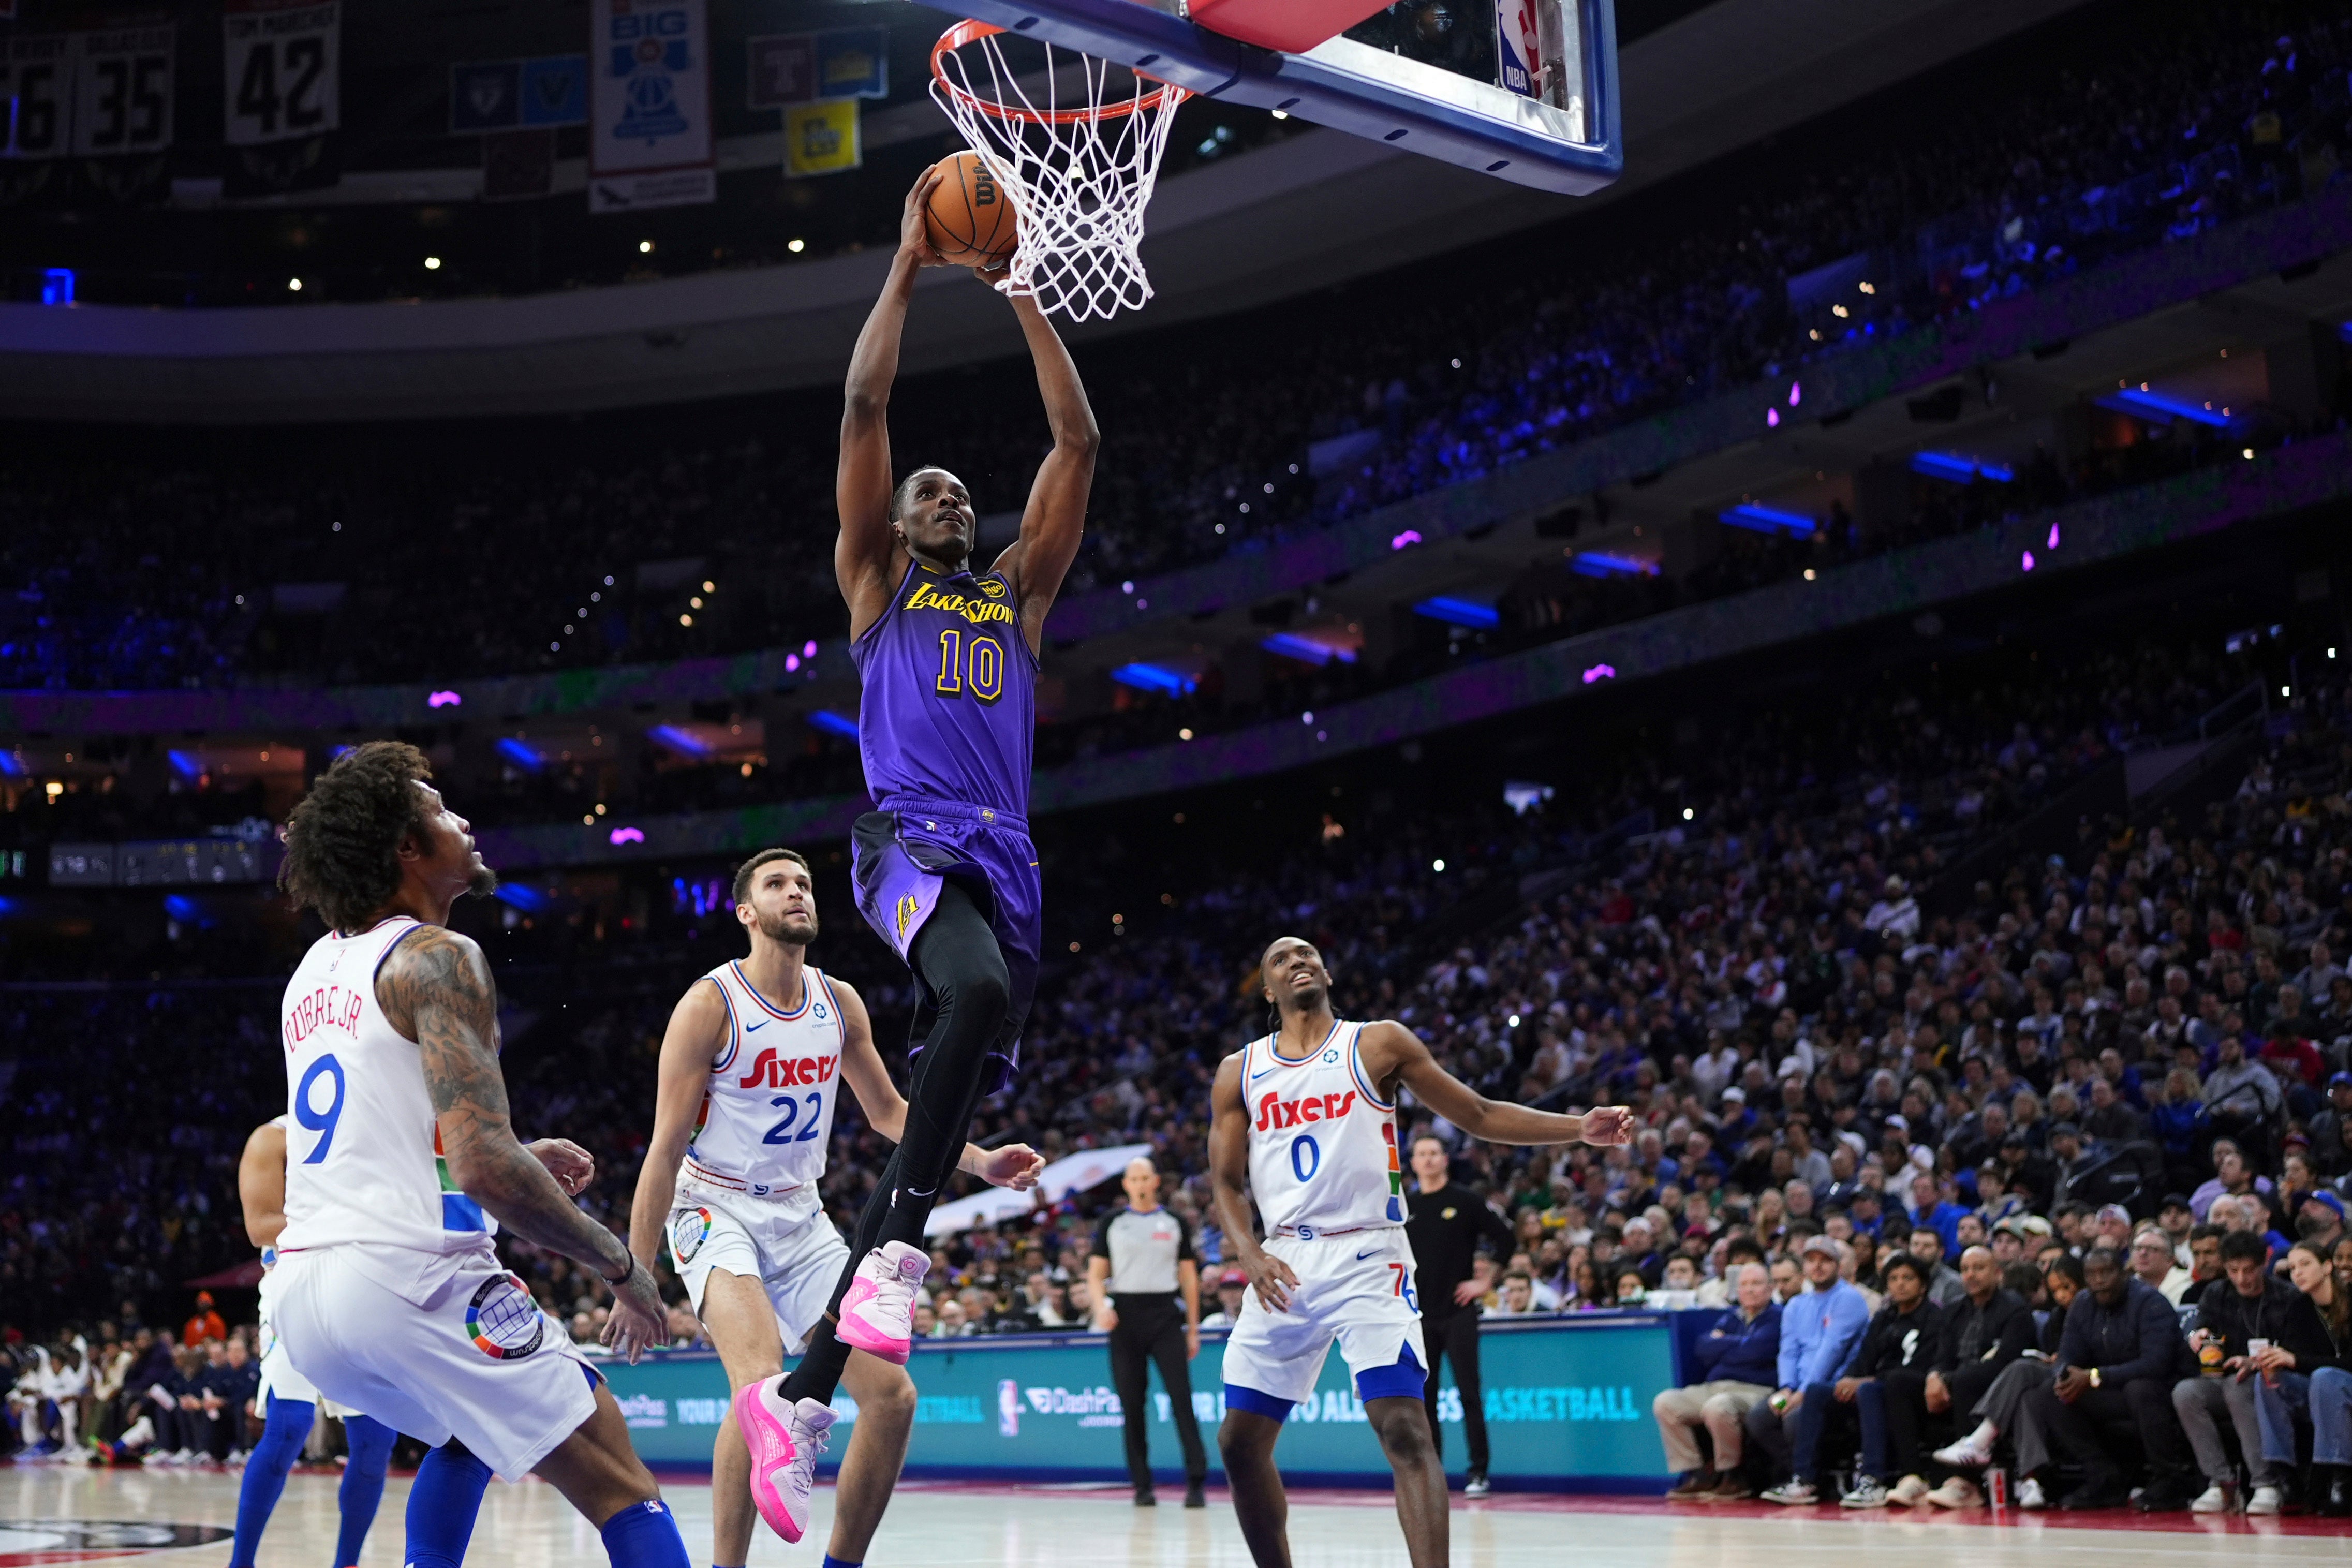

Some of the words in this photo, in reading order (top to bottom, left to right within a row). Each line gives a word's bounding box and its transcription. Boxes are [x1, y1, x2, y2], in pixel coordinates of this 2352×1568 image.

[611, 10, 687, 40] BIG
[92, 57, 166, 147] 35
[236, 37, 324, 134] 42
[1506, 65, 1528, 91] NBA
[936, 629, 1004, 705] 10
[740, 1047, 838, 1089] Sixers
[295, 1053, 345, 1164] 9
[762, 1092, 822, 1145] 22
[1256, 1090, 1356, 1132] Sixers
[1291, 1134, 1320, 1182] 0
[1388, 1263, 1418, 1314] 76
[1053, 1385, 1125, 1414] DashPa
[1321, 1389, 1369, 1423] ALL
[1483, 1386, 1640, 1422] ASKETBALL
